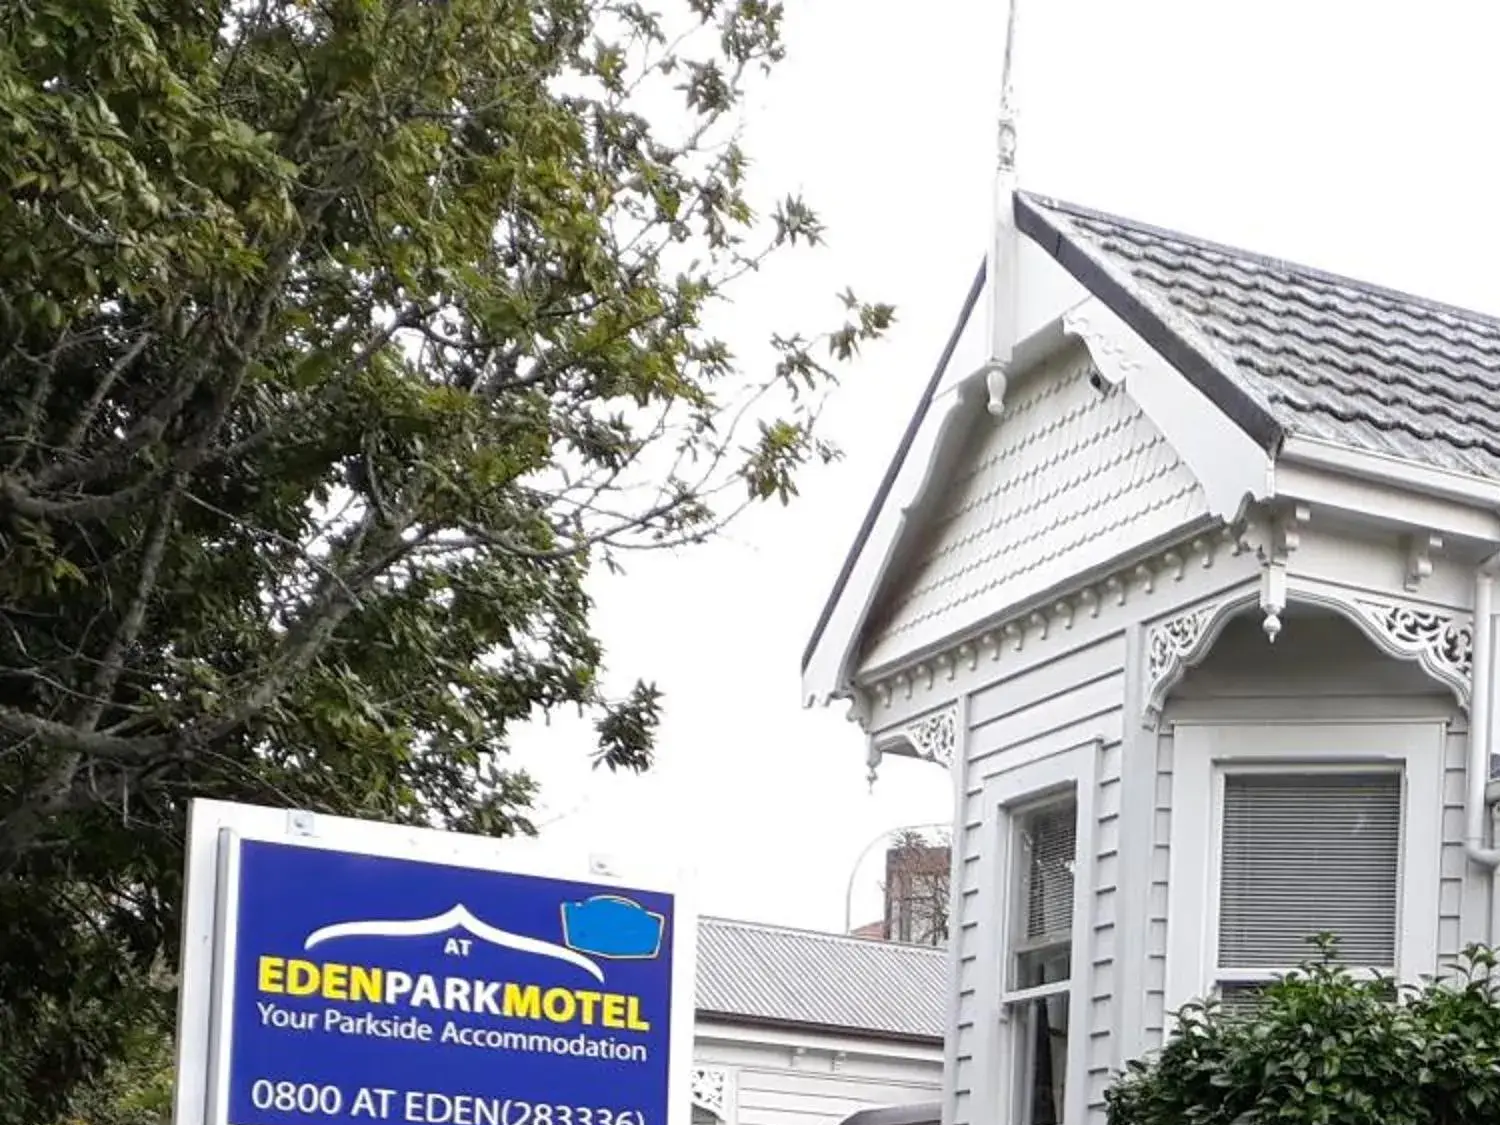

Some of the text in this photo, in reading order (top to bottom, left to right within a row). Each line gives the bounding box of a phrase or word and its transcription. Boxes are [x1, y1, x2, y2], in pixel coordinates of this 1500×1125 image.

[443, 937, 473, 957] AT
[255, 1001, 648, 1063] Your Parkside Accommodation
[251, 1078, 343, 1116] 0800
[350, 1086, 398, 1119] AT
